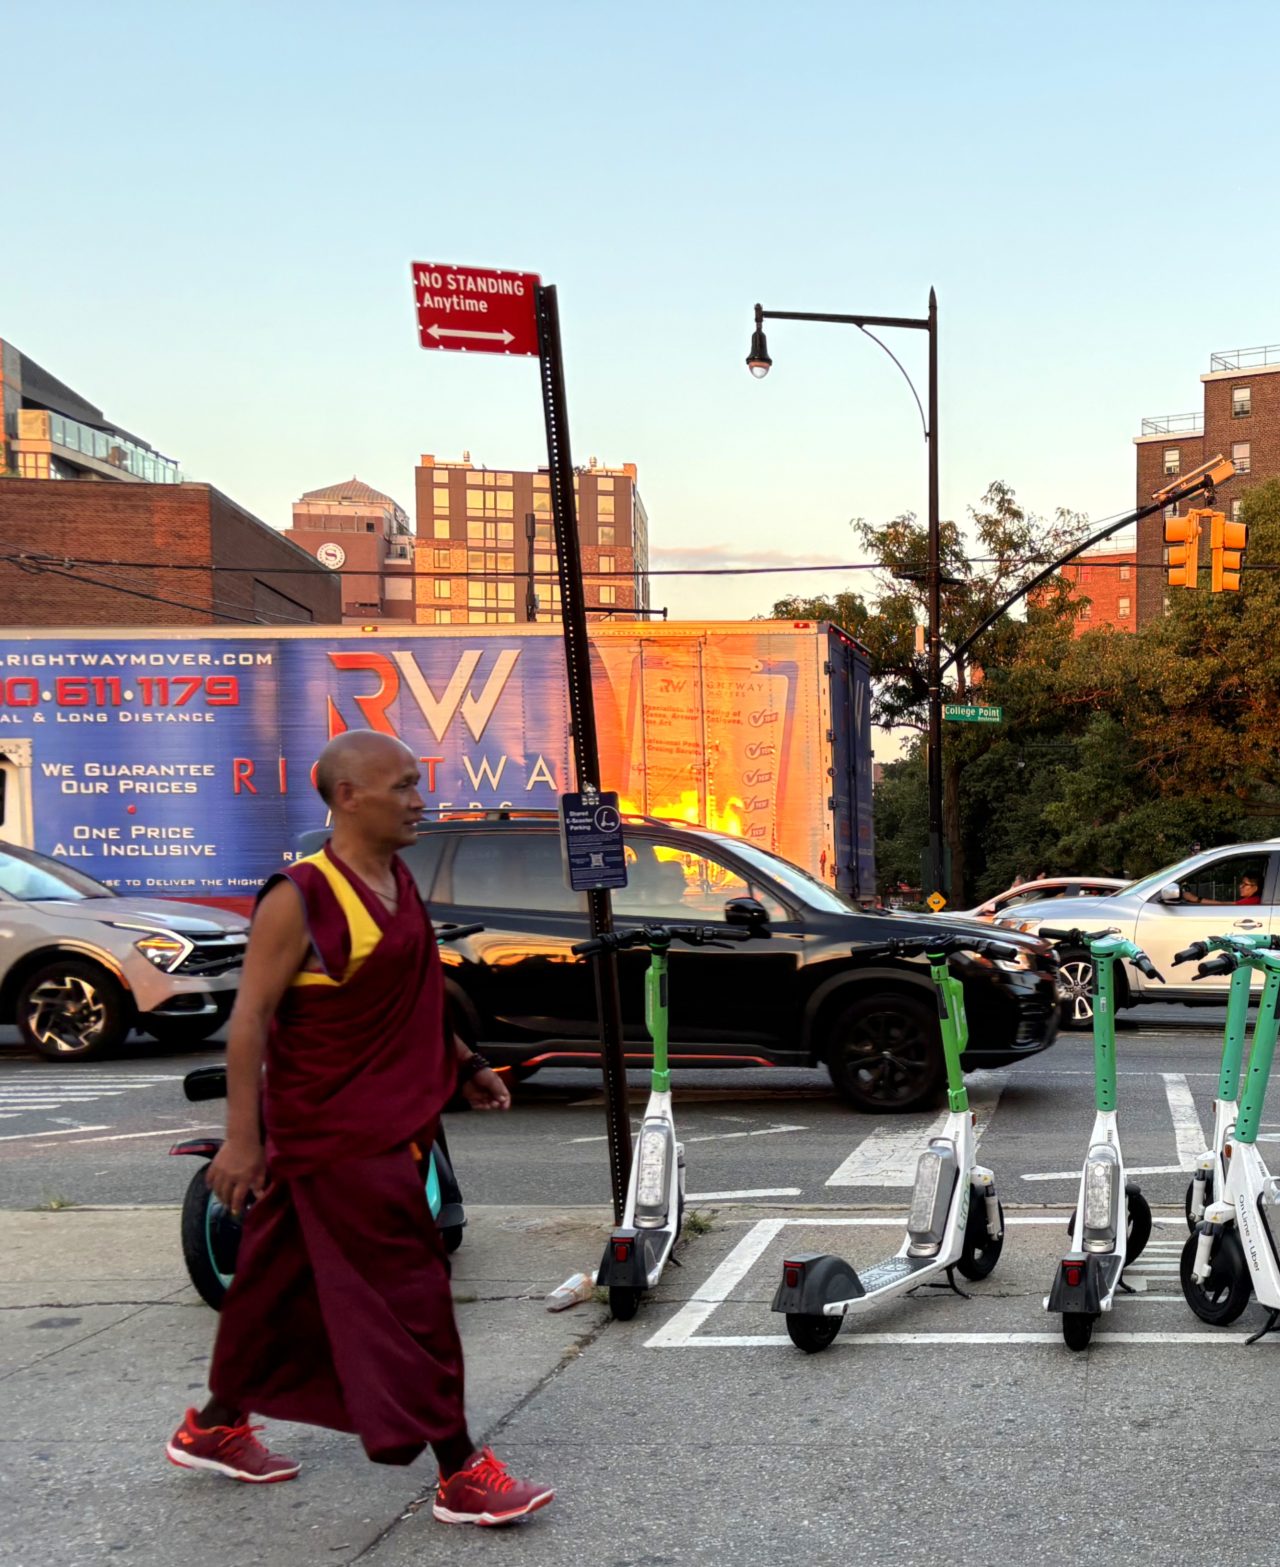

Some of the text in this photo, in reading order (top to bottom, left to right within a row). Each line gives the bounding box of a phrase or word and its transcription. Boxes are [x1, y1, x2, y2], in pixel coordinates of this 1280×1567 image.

[419, 271, 525, 296] NO STANDING
[423, 292, 488, 313] Anytime
[693, 680, 764, 692] RGHTWAY
[327, 649, 522, 744] RW
[32, 711, 48, 723] &
[945, 705, 999, 718] College Point
[73, 826, 121, 839] ONE
[1249, 1246, 1260, 1272] Uber
